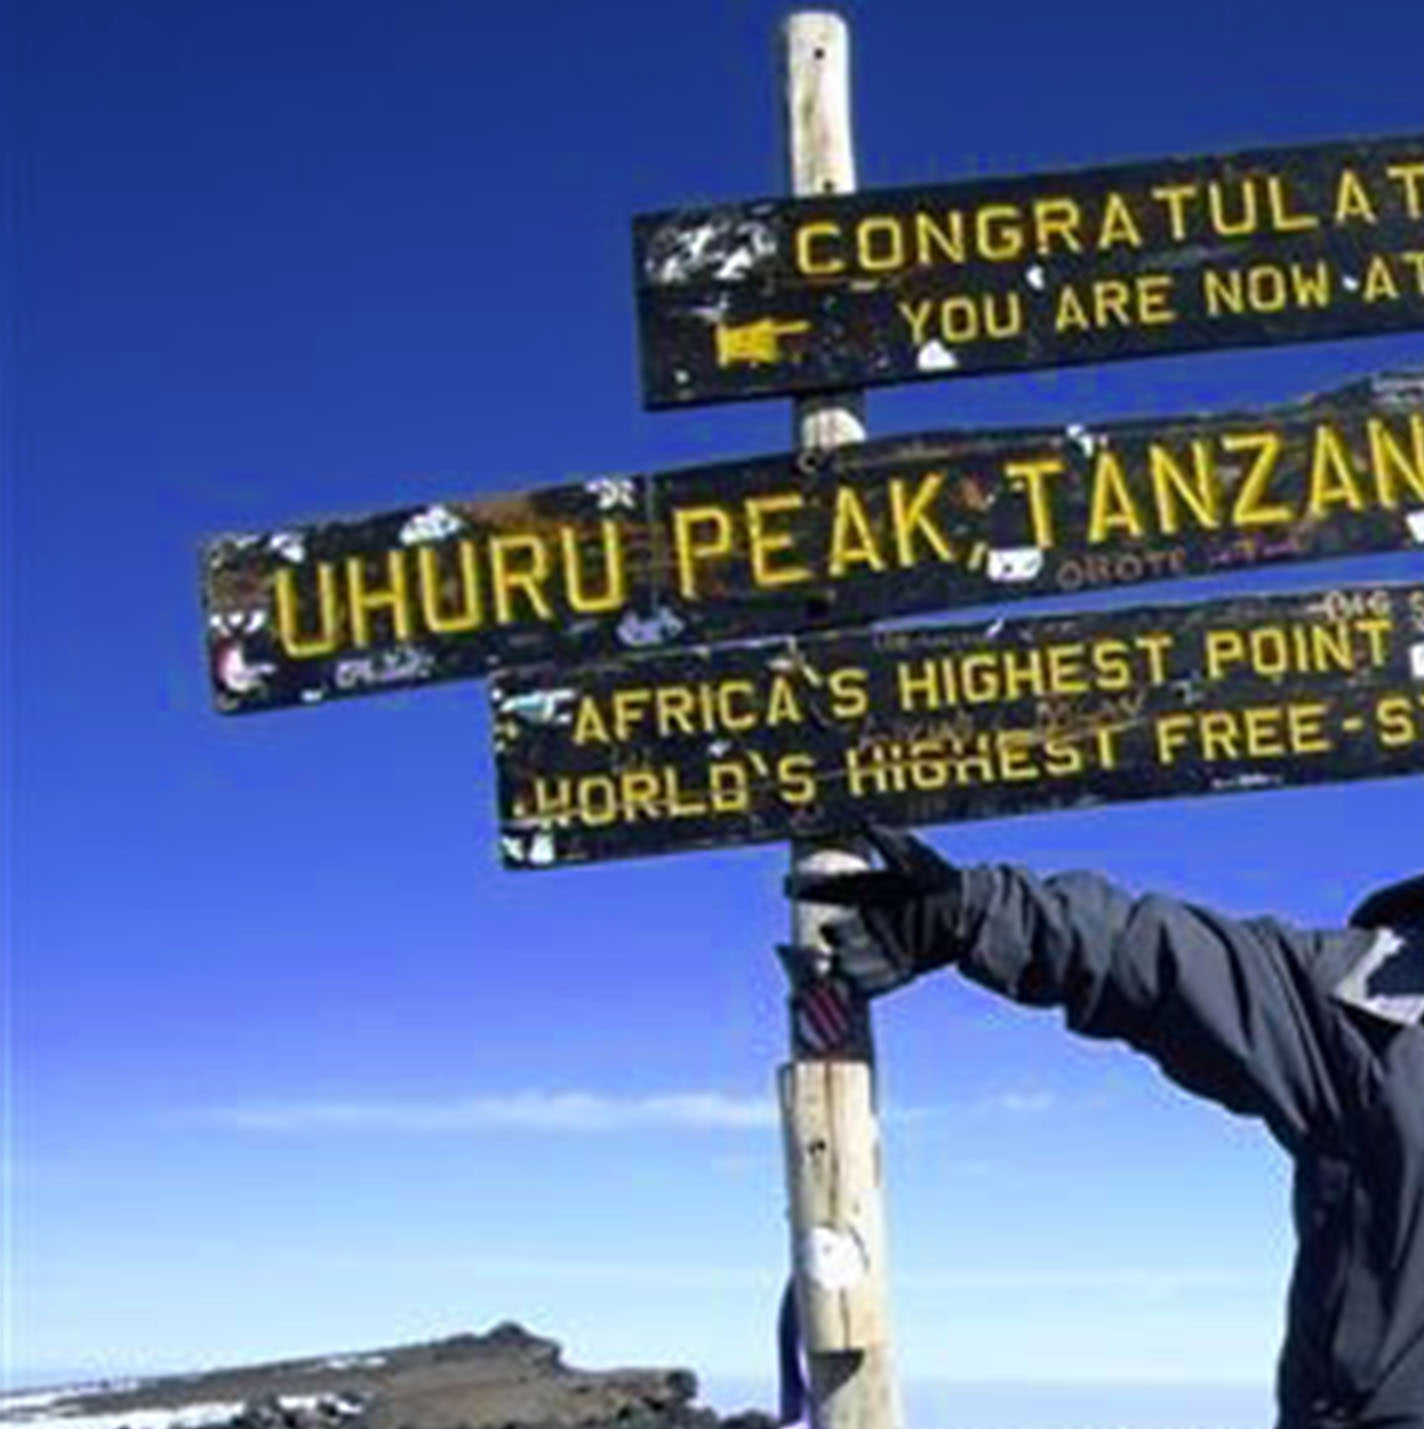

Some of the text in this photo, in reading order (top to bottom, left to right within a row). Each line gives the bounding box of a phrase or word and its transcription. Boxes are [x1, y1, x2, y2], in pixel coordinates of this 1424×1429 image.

[899, 291, 1022, 343] YOU
[1054, 275, 1177, 332] ARE
[1204, 259, 1330, 317] NOW
[275, 519, 625, 659] UHURU
[672, 472, 988, 600] PEAK,
[572, 662, 870, 746] AFRICA'S
[898, 636, 1174, 712] HIGHEST
[1205, 619, 1394, 680] POINT
[532, 752, 817, 830] WORLD'S
[846, 725, 1117, 797] HIGHEST
